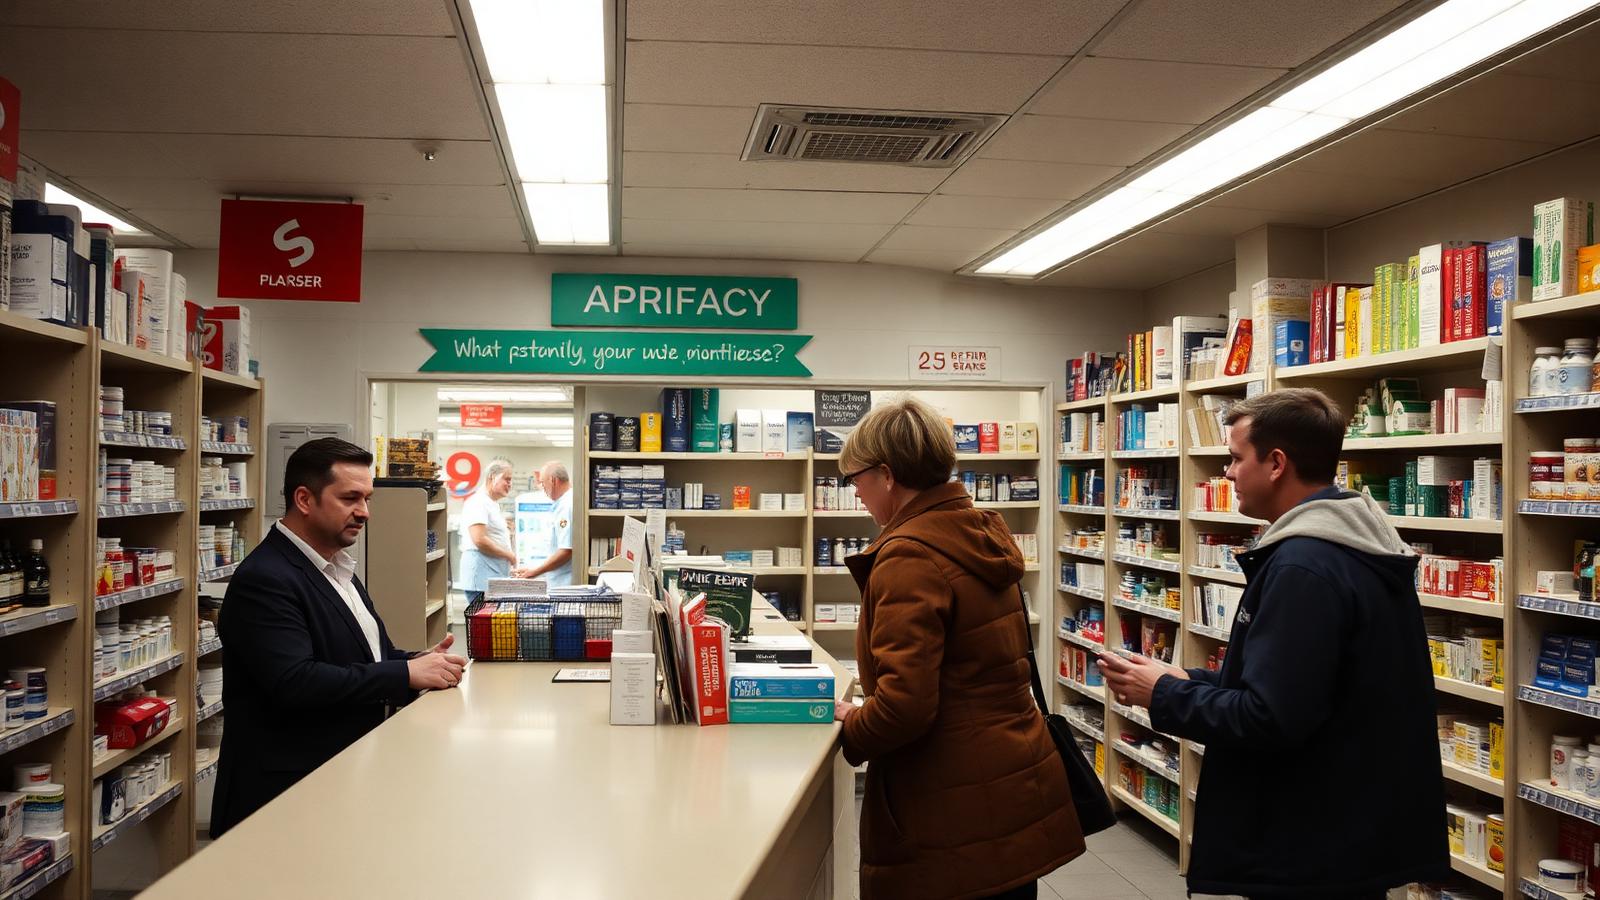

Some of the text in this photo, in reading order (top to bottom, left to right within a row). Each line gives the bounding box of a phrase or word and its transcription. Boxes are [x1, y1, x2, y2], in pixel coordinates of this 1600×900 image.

[260, 274, 322, 288] PLARSER
[583, 285, 772, 316] APRIFACY
[454, 336, 502, 358] What
[593, 347, 635, 370] your
[918, 351, 946, 371] 25
